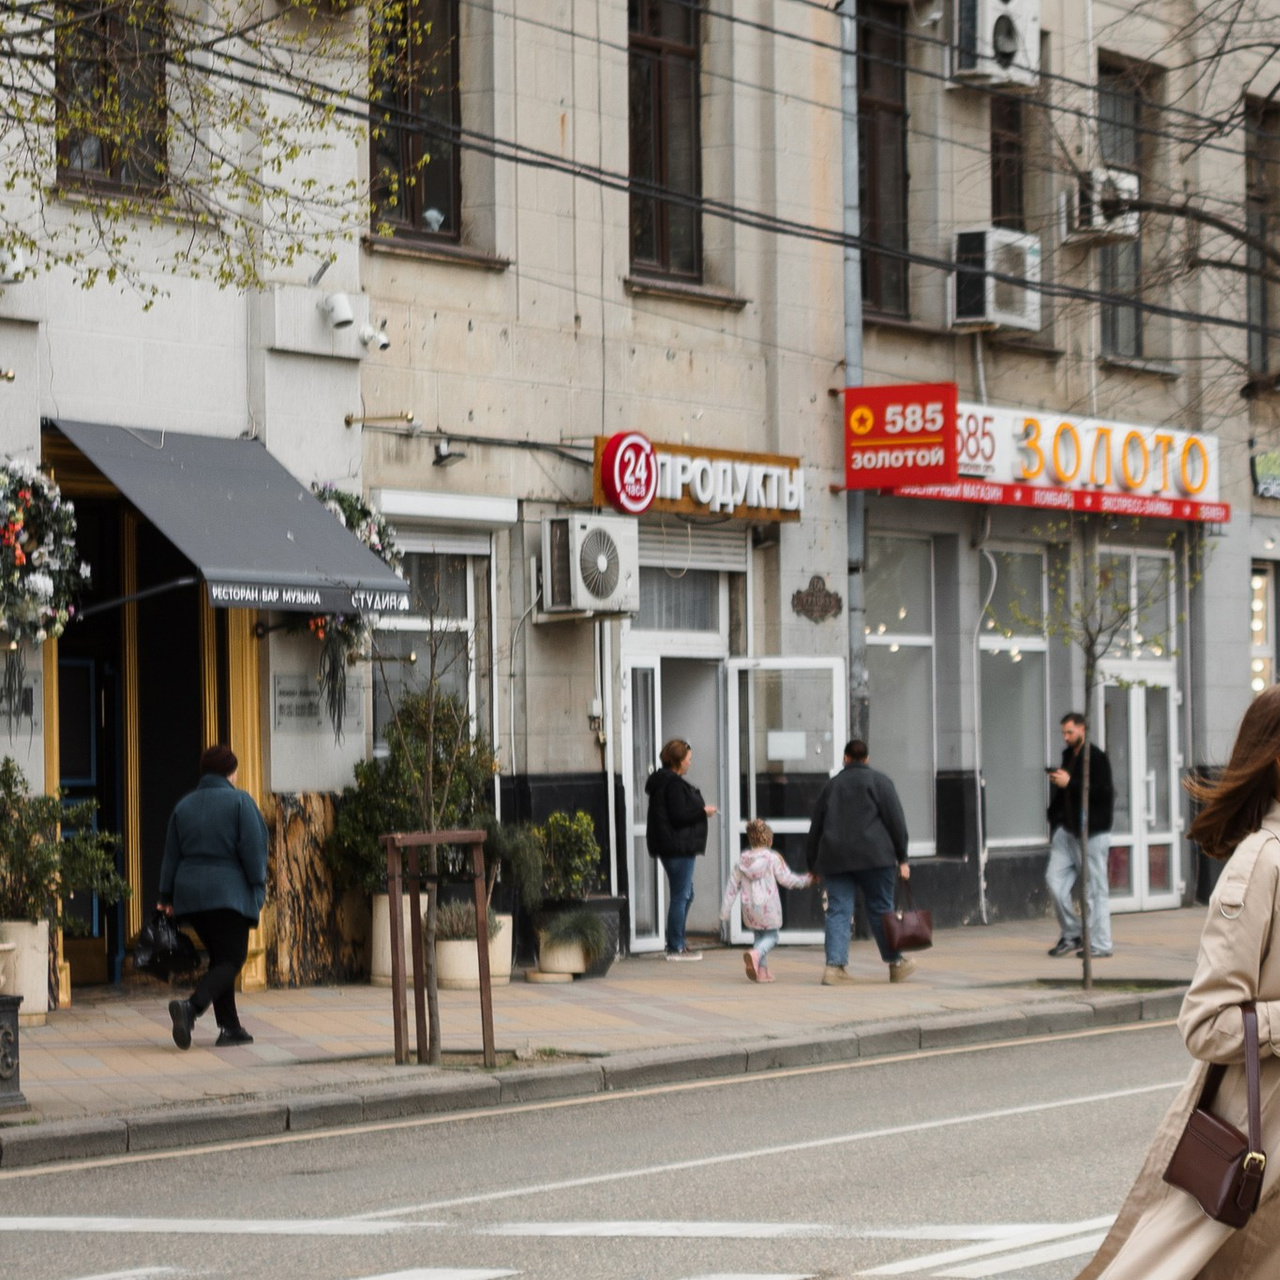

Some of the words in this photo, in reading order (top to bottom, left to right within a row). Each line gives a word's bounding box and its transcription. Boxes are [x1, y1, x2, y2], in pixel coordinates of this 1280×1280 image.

[884, 402, 944, 434] 585
[623, 447, 648, 485] 24
[851, 446, 945, 470] ЗОЛОТОЙ
[1016, 417, 1209, 495] ЗОЛОТО
[625, 483, 647, 498] часа
[656, 452, 804, 513] ПРОДУКТЫ
[962, 483, 1003, 501] МАГАЗИН
[1033, 489, 1075, 508] ЛОМБАРД
[212, 586, 258, 602] РЕСТОРАН
[262, 587, 279, 603] БАР
[282, 589, 321, 605] МУЗЫКА
